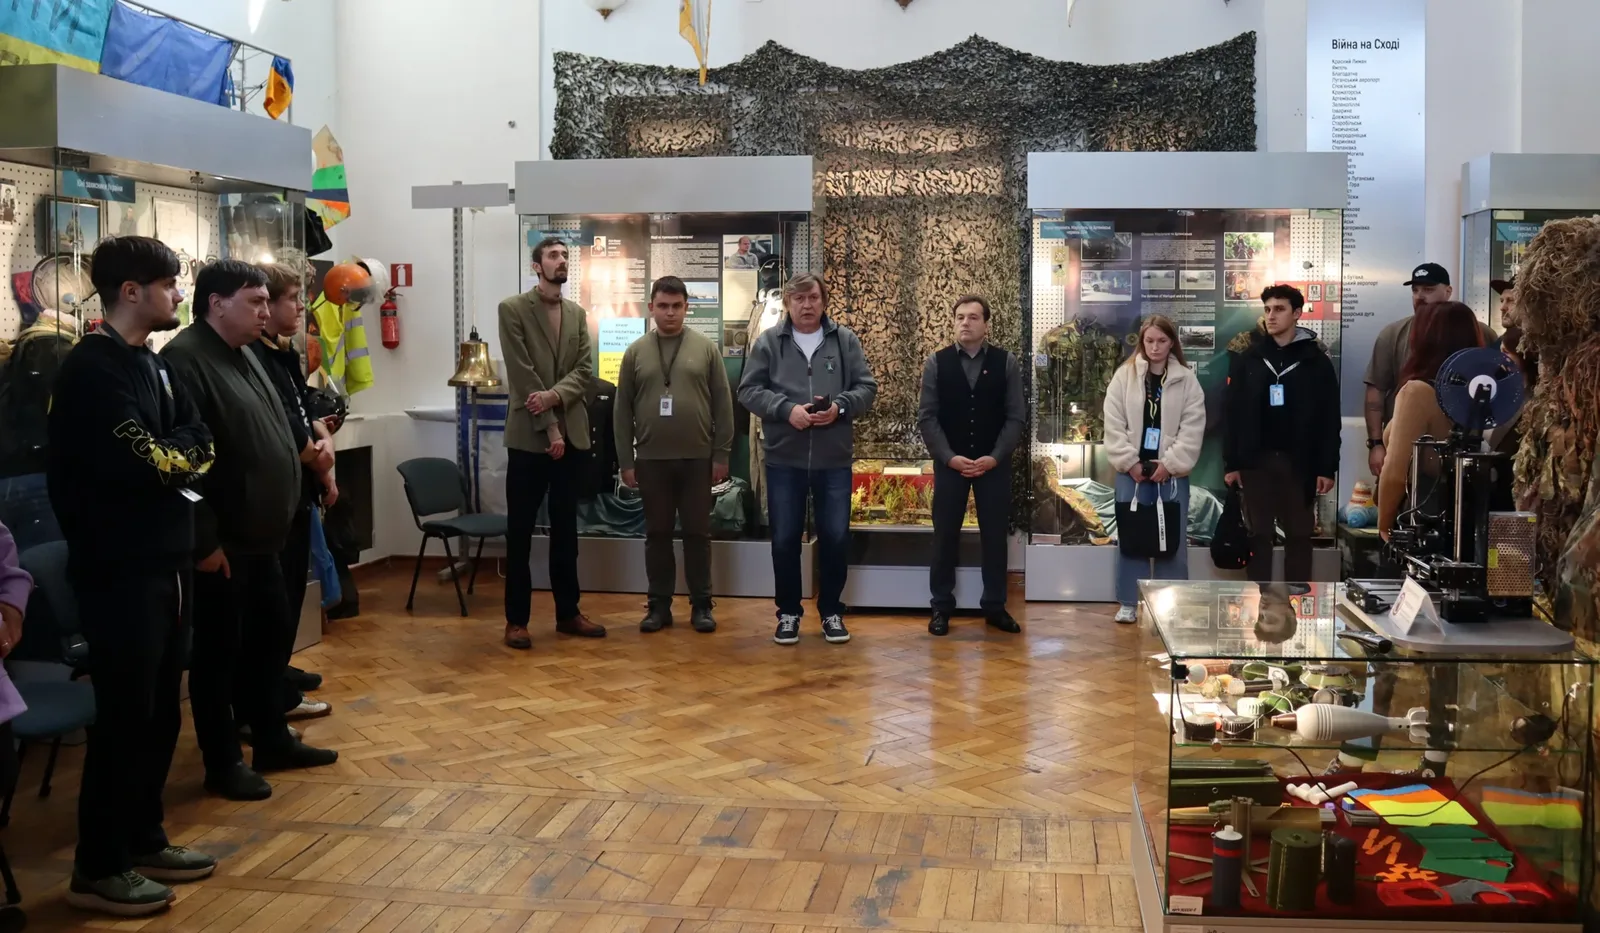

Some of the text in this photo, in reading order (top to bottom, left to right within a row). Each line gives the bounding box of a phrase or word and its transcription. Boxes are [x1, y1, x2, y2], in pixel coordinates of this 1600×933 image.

[1331, 38, 1400, 51] Війна на Сході
